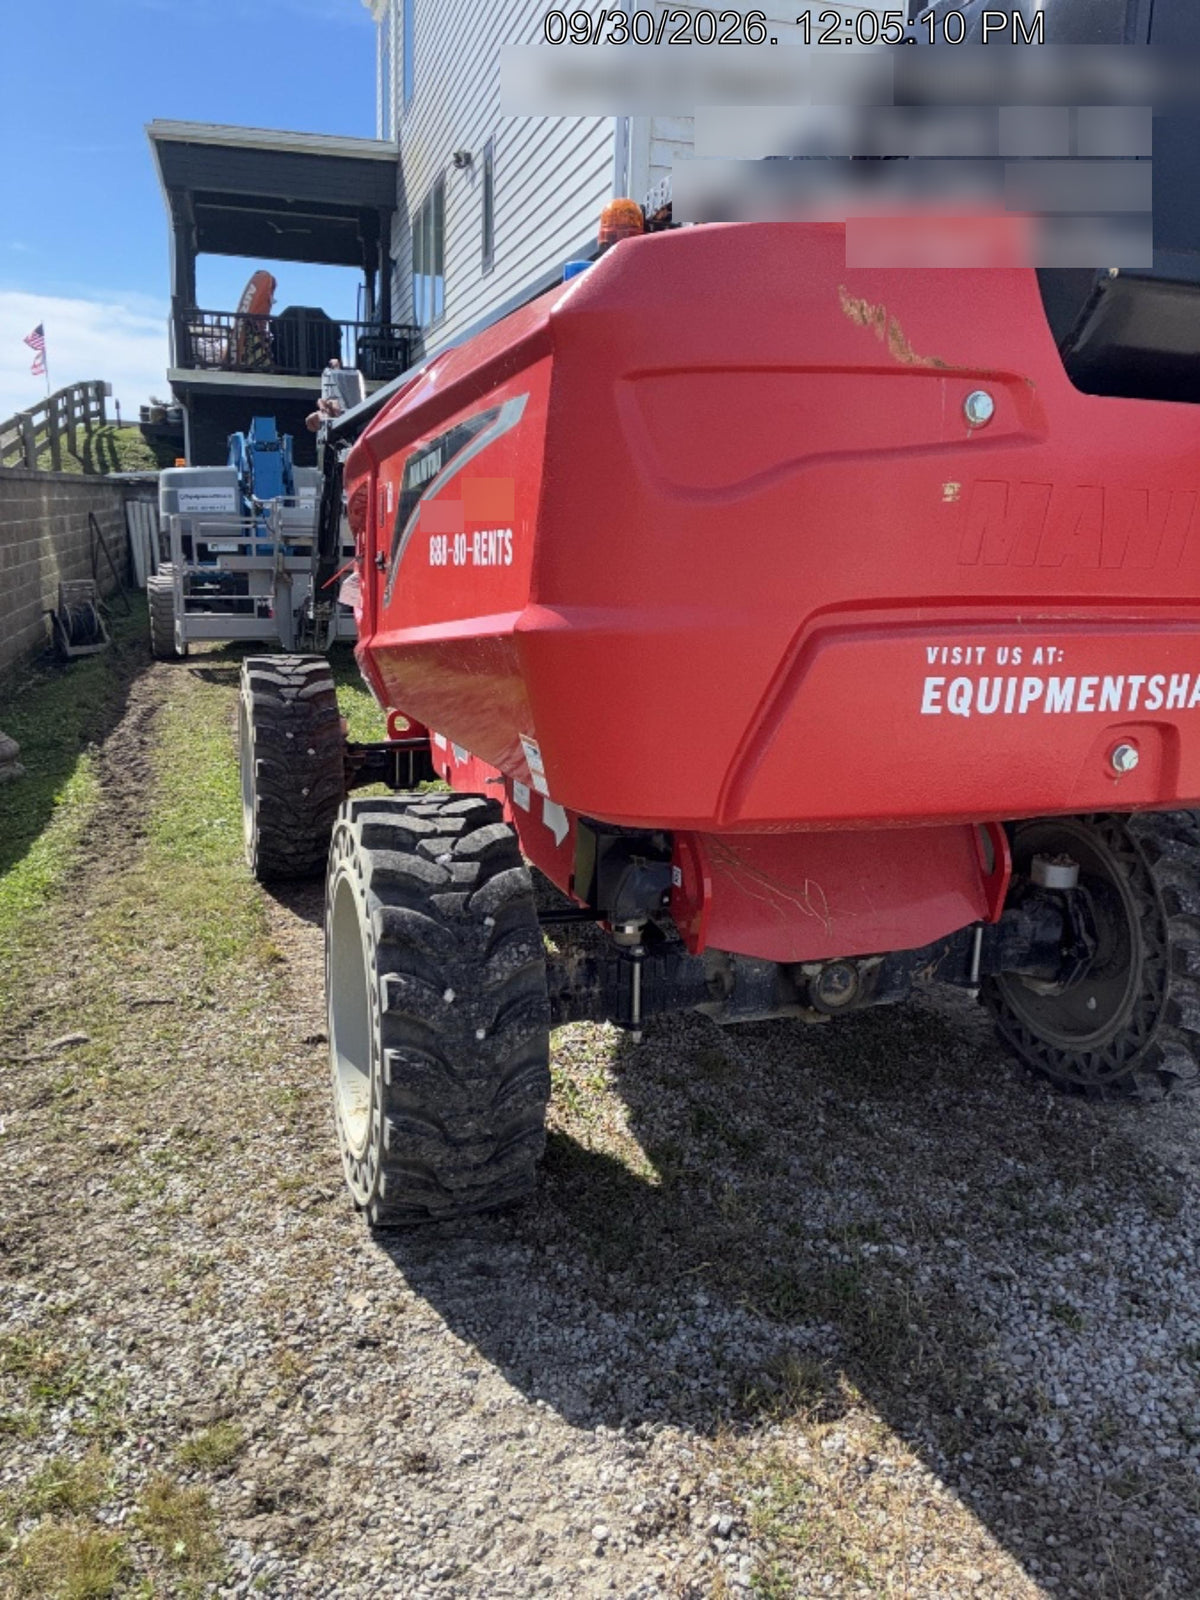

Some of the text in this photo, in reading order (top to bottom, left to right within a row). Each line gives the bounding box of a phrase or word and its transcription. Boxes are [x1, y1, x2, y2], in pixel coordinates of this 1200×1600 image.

[926, 647, 1064, 665] VISIT US AT:
